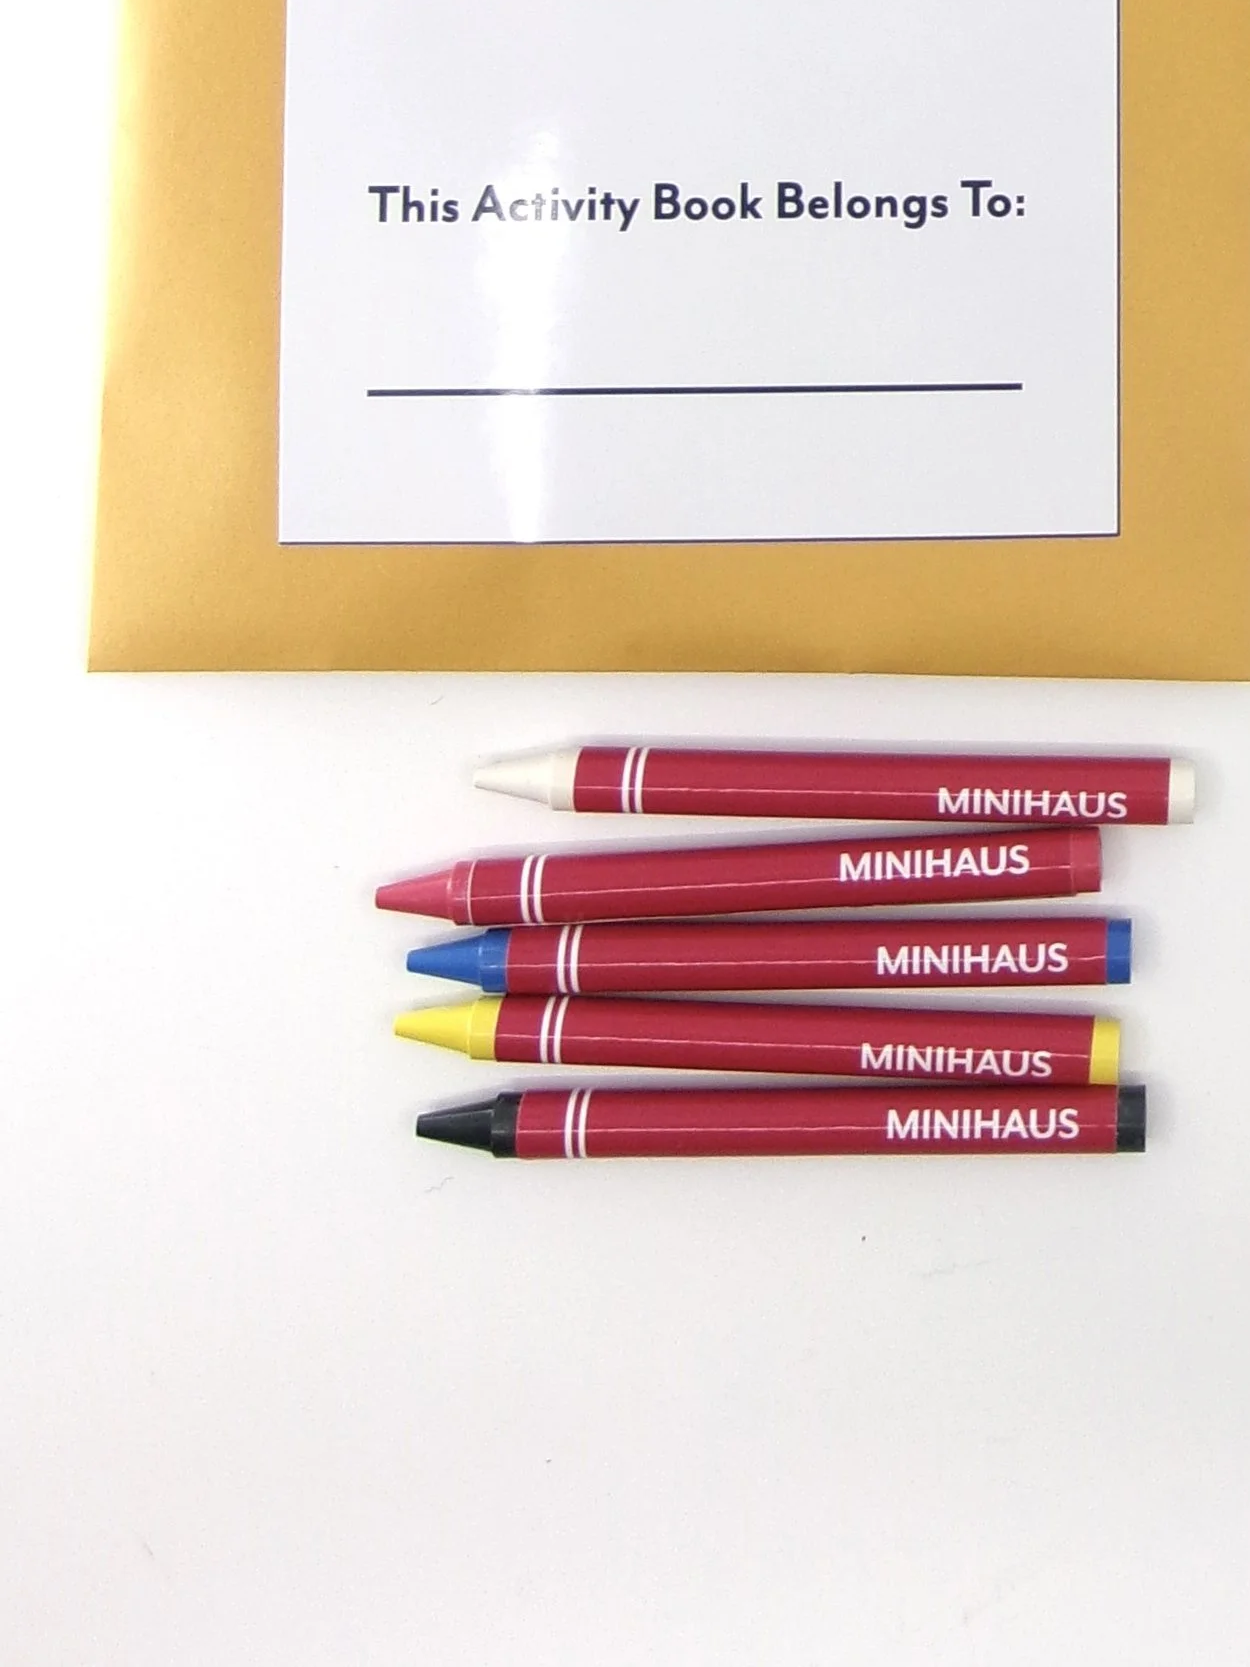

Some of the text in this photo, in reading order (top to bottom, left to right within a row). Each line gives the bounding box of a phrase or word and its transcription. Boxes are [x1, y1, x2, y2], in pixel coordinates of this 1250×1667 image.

[367, 179, 1026, 232] This Activity Book Belongs To:
[937, 786, 1128, 819] MINIHAUS
[839, 844, 1030, 882] MINIHAUS
[876, 942, 1069, 975] MINIHAUS
[860, 1042, 1053, 1078] MINIHAUS
[885, 1108, 1080, 1140] MINIHAUS
